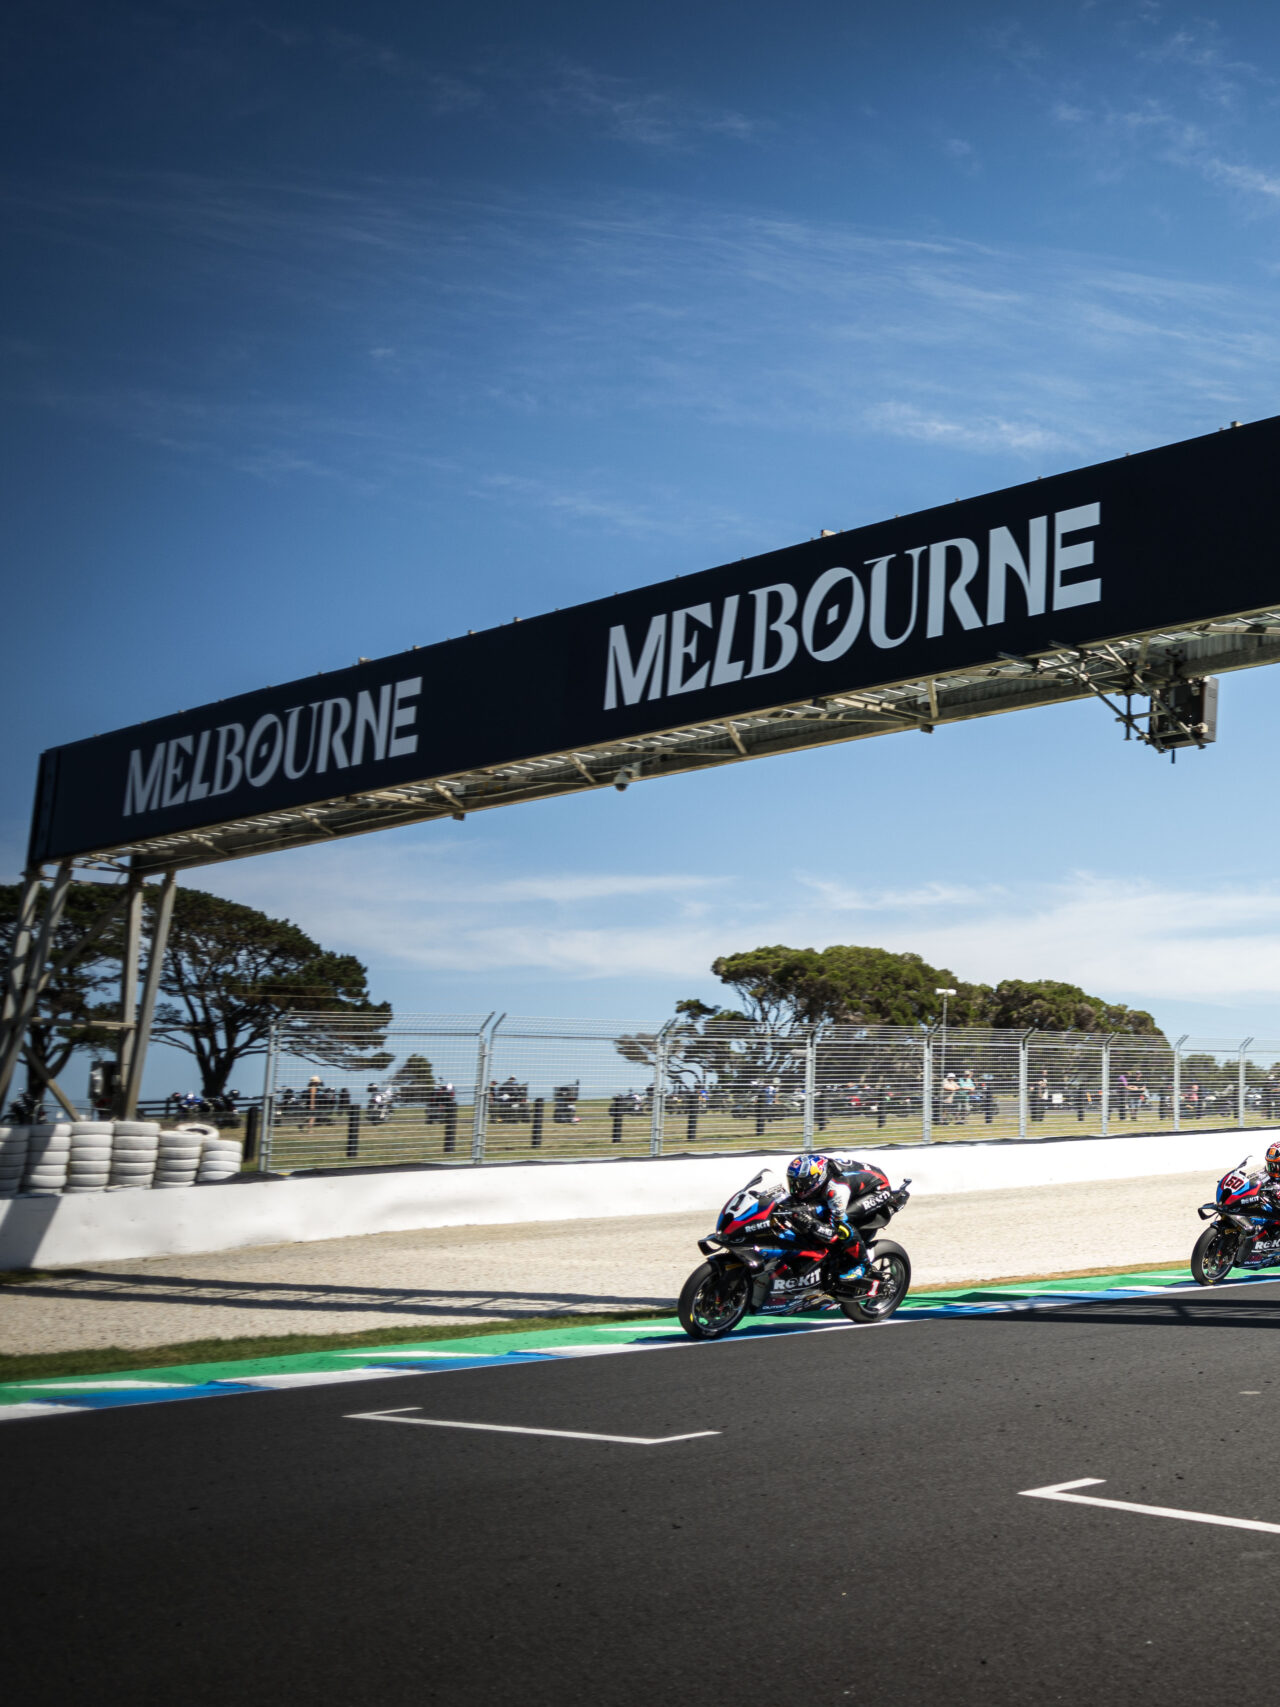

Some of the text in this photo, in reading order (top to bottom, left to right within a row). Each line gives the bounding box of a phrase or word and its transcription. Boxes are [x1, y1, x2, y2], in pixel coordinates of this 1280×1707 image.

[604, 502, 1103, 711] MELBOURNE
[122, 676, 423, 816] MELBOURNE
[1225, 1176, 1244, 1190] 60
[730, 1194, 746, 1211] 1
[867, 1280, 880, 1297] 1
